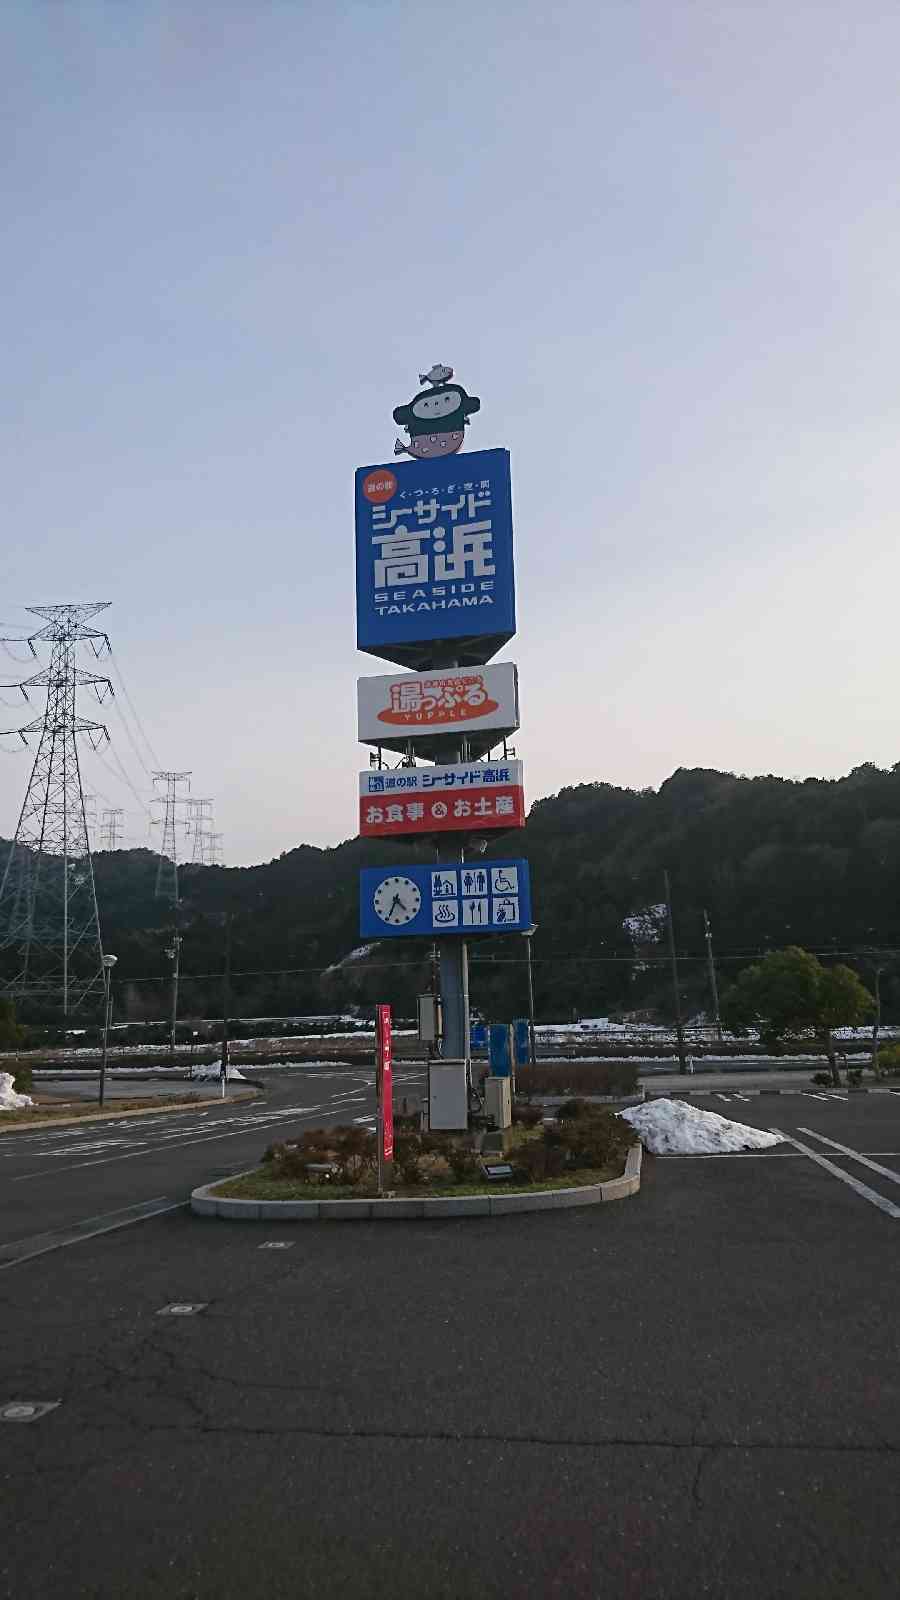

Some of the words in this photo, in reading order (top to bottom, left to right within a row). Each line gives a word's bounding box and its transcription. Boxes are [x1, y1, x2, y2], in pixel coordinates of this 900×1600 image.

[372, 491, 492, 530] シーサイド
[371, 520, 495, 588] 高浜
[374, 581, 494, 603] SEASIDE
[375, 595, 494, 616] TAKAHAMA
[386, 776, 417, 788] 道の駅
[366, 802, 424, 823] お食事
[454, 796, 514, 816] お土産
